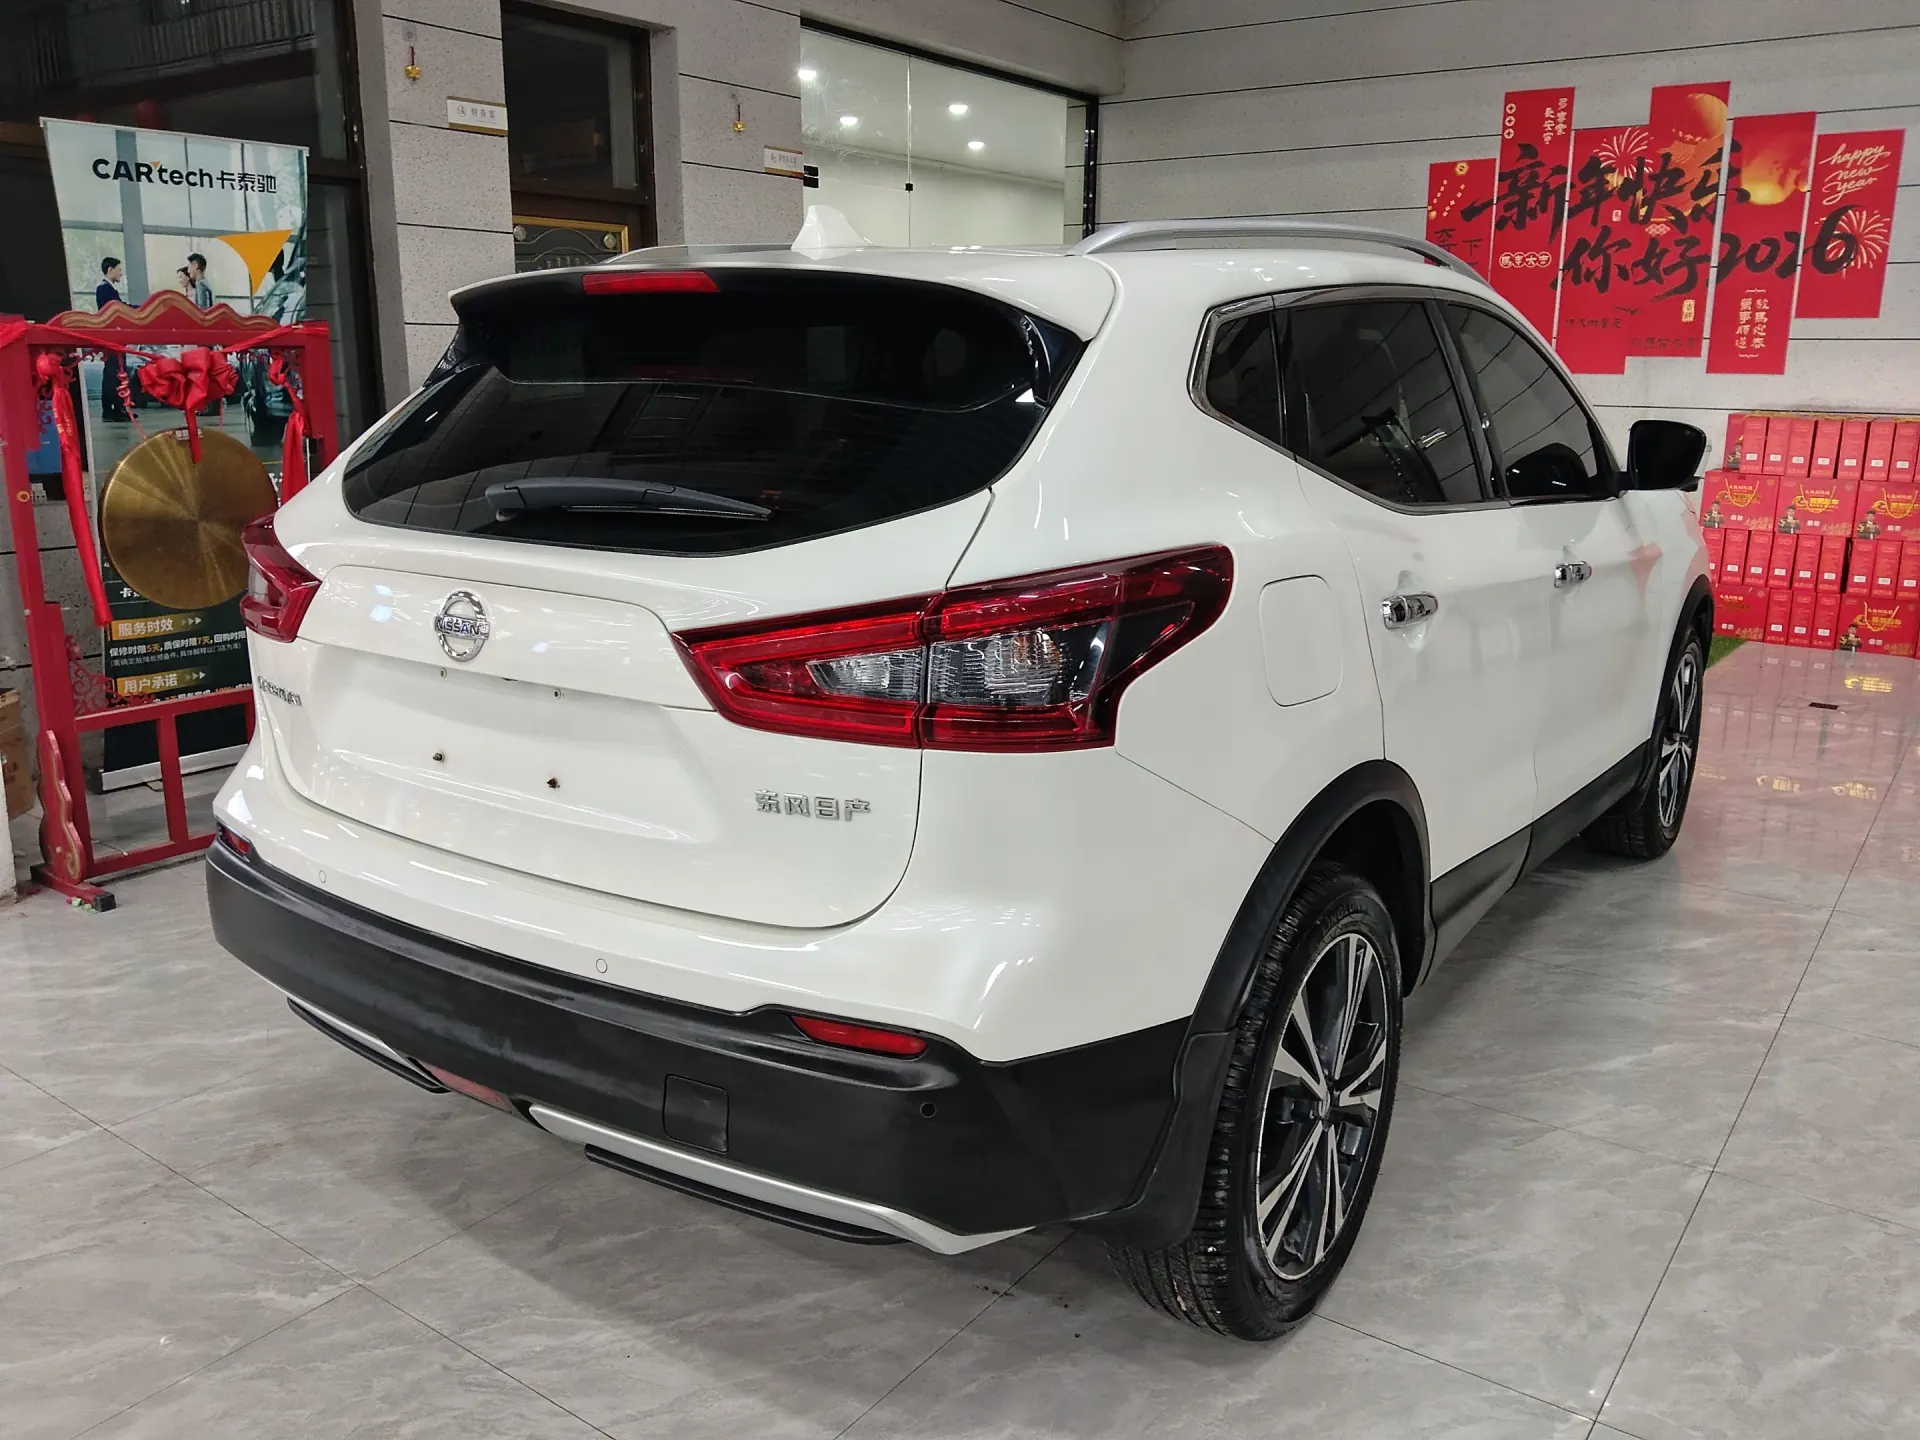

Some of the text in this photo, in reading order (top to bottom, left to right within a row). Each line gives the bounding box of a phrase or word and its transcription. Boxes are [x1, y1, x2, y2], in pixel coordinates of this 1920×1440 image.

[1819, 143, 1891, 168] happy
[1824, 164, 1890, 182] new
[1461, 140, 1751, 244] 新年快乐
[1822, 178, 1878, 205] year
[118, 618, 174, 637] 服务时效
[437, 619, 480, 635] NISSAN
[123, 673, 178, 694] 用户承诺
[755, 789, 871, 822] 东风日产
